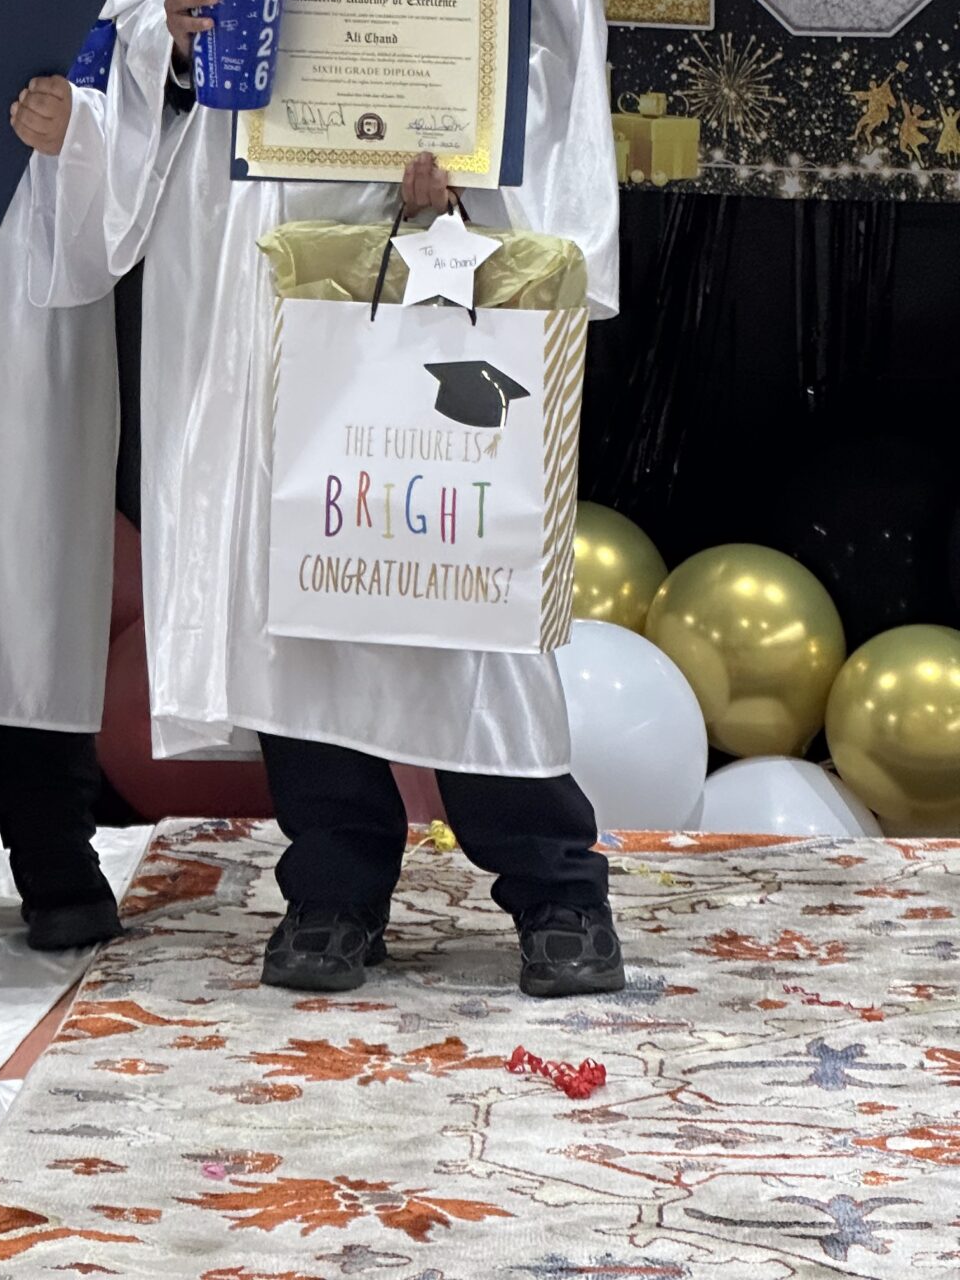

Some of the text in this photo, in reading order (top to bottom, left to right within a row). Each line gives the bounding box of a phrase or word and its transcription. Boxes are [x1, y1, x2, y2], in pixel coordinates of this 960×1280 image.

[344, 31, 398, 45] Ali Chand
[312, 65, 431, 78] SIXTH GRADE DIPLOMA
[419, 246, 433, 256] To
[434, 257, 446, 269] Ali
[345, 425, 482, 462] THE FUTURE IS
[324, 470, 492, 545] BRIGHT
[298, 553, 515, 604] CONGRATULATIONS!
